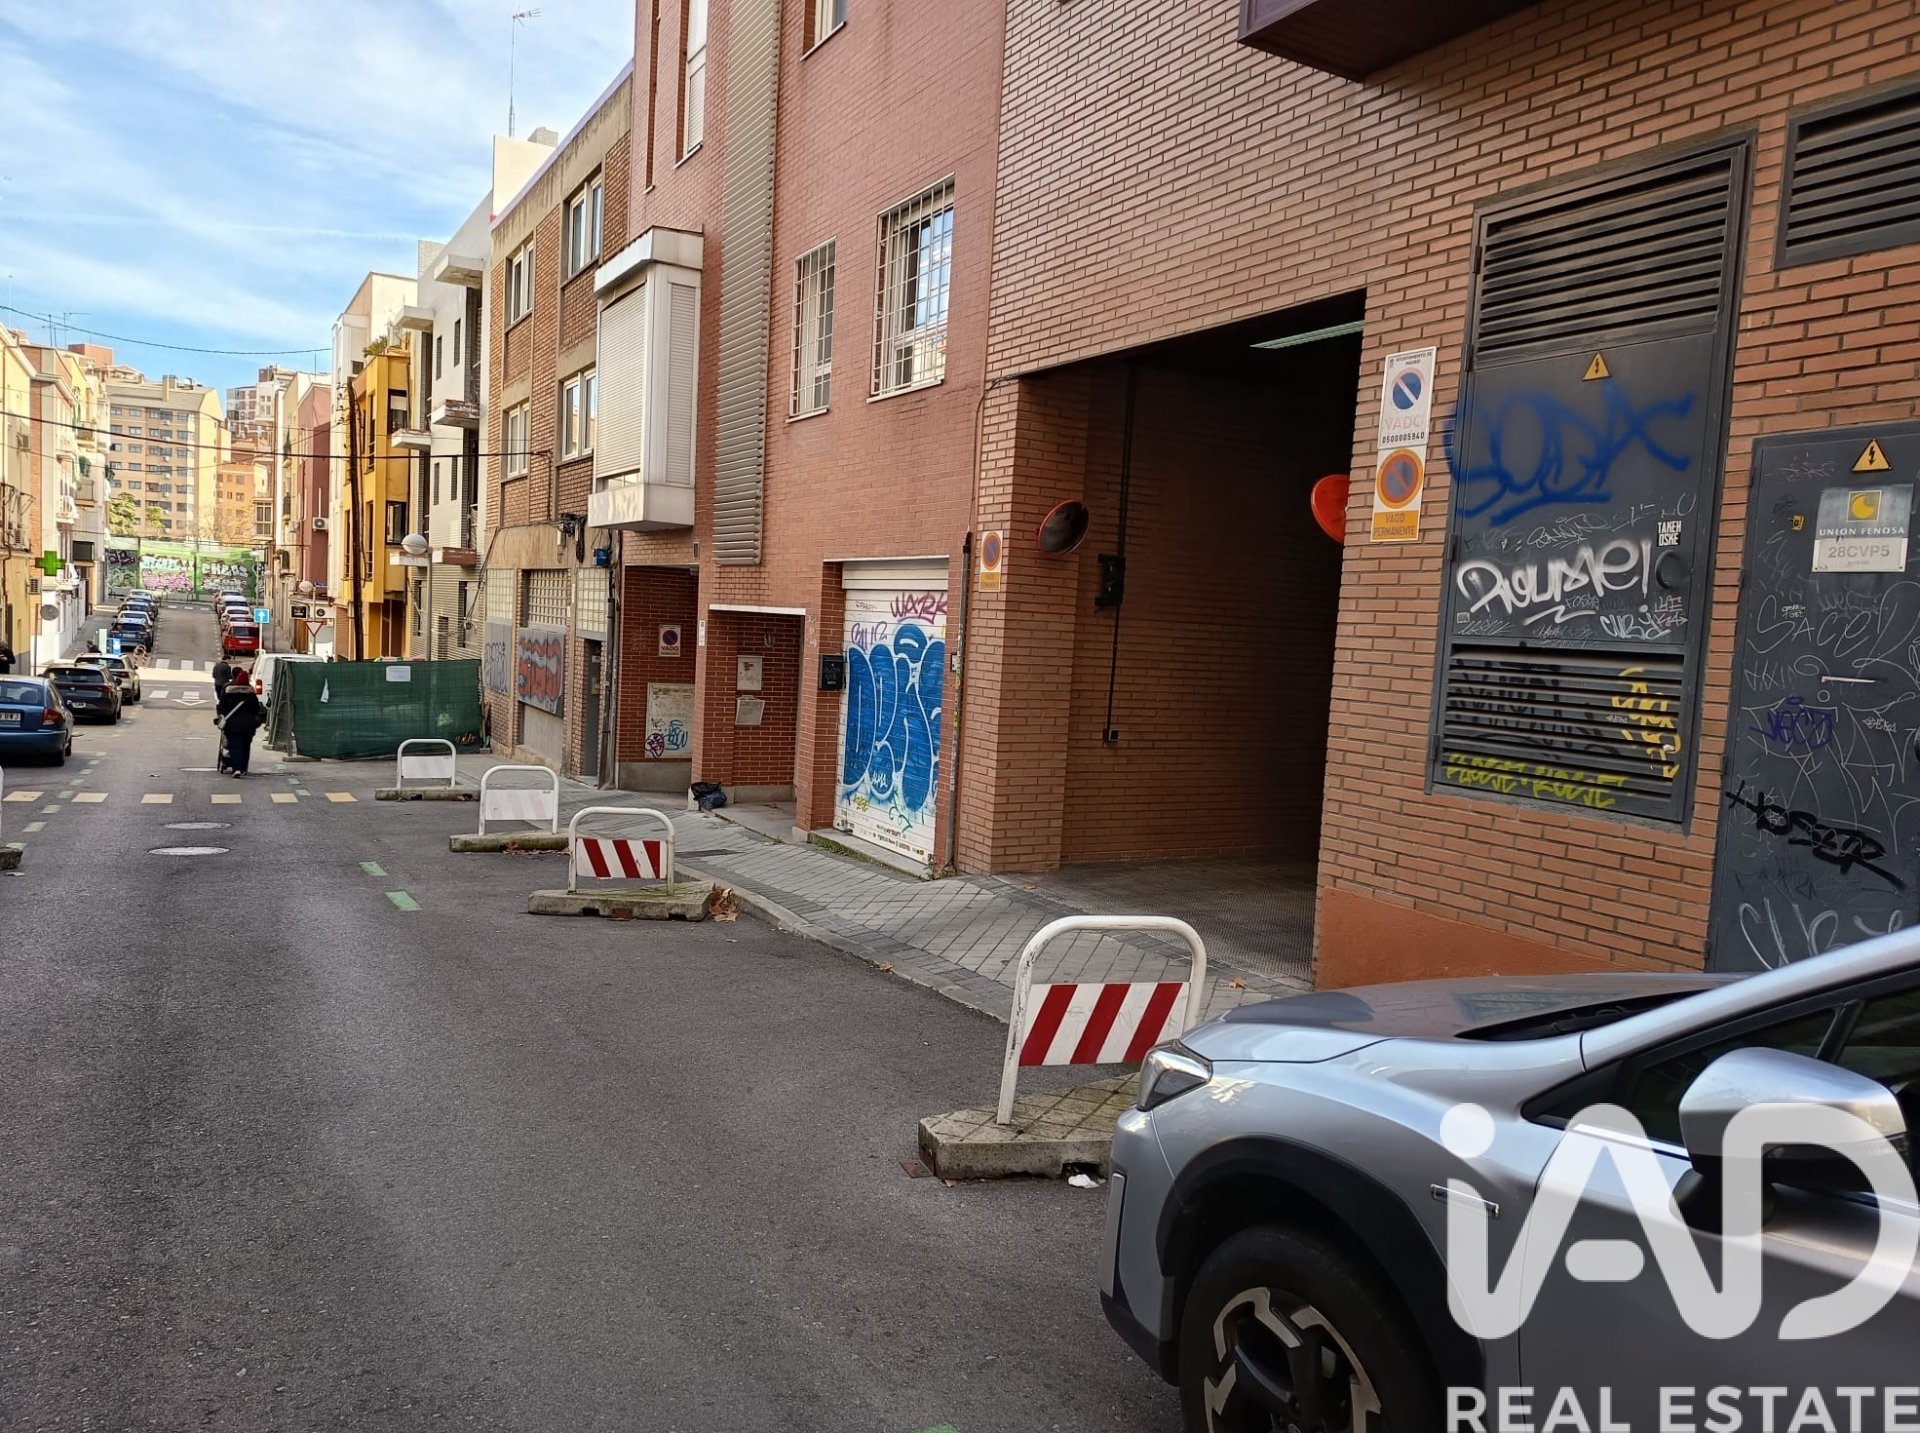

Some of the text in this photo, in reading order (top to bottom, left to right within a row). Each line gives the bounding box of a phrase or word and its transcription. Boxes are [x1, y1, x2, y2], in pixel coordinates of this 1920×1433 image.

[1385, 512, 1406, 523] VADO
[1373, 525, 1416, 537] PERMANENTE
[1819, 526, 1905, 536] UNION FENOSA
[1828, 545, 1890, 558] 28CVP5
